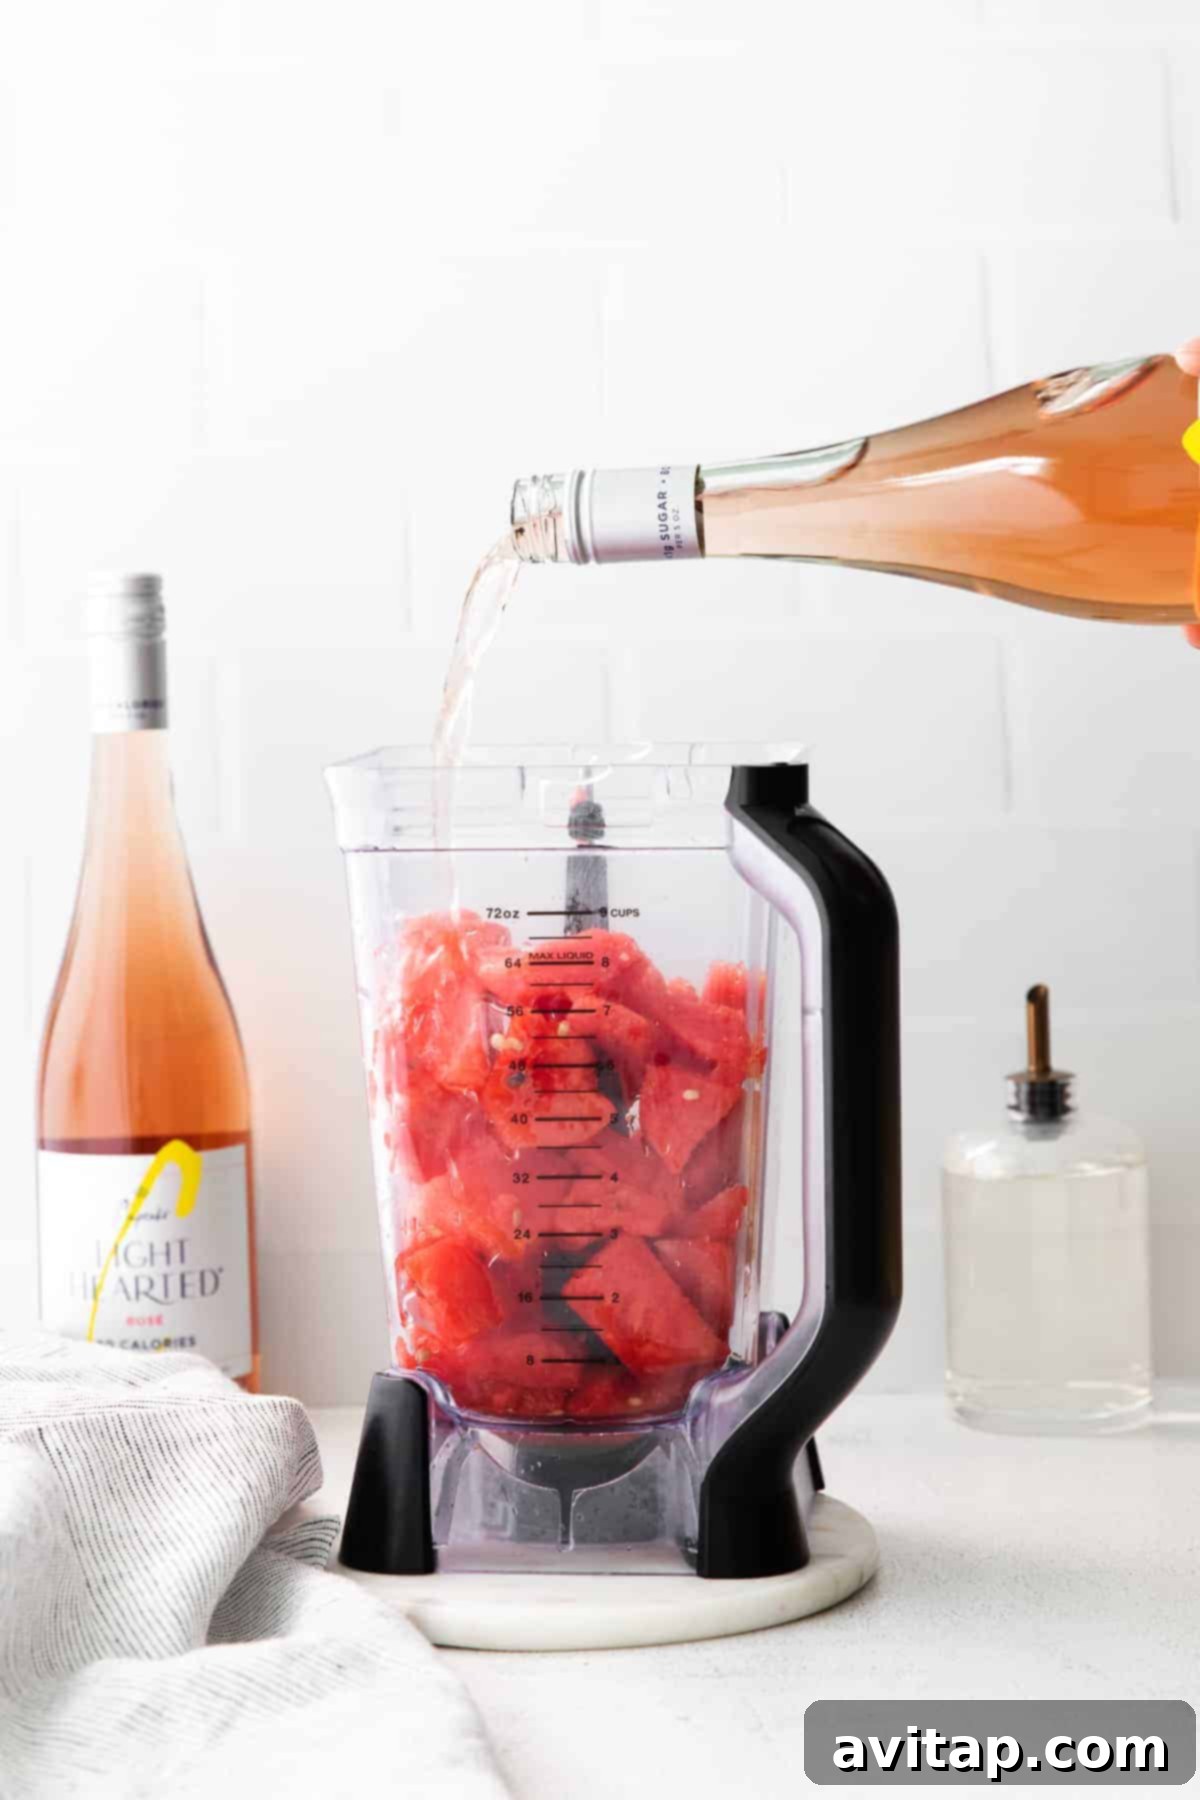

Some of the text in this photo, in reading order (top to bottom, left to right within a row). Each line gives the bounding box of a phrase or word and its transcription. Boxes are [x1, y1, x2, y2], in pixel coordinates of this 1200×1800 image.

[657, 491, 671, 541] SUGAR
[486, 907, 520, 919] 72oz
[610, 908, 640, 918] CUPS
[528, 952, 594, 960] MAX LIQUID
[504, 957, 610, 968] 64 8
[507, 1006, 612, 1017] 56 7
[511, 1114, 528, 1124] 40
[512, 1172, 619, 1184] 32 4
[513, 1229, 618, 1240] 24 3
[517, 1293, 620, 1303] 16 2
[526, 1356, 534, 1366] 8
